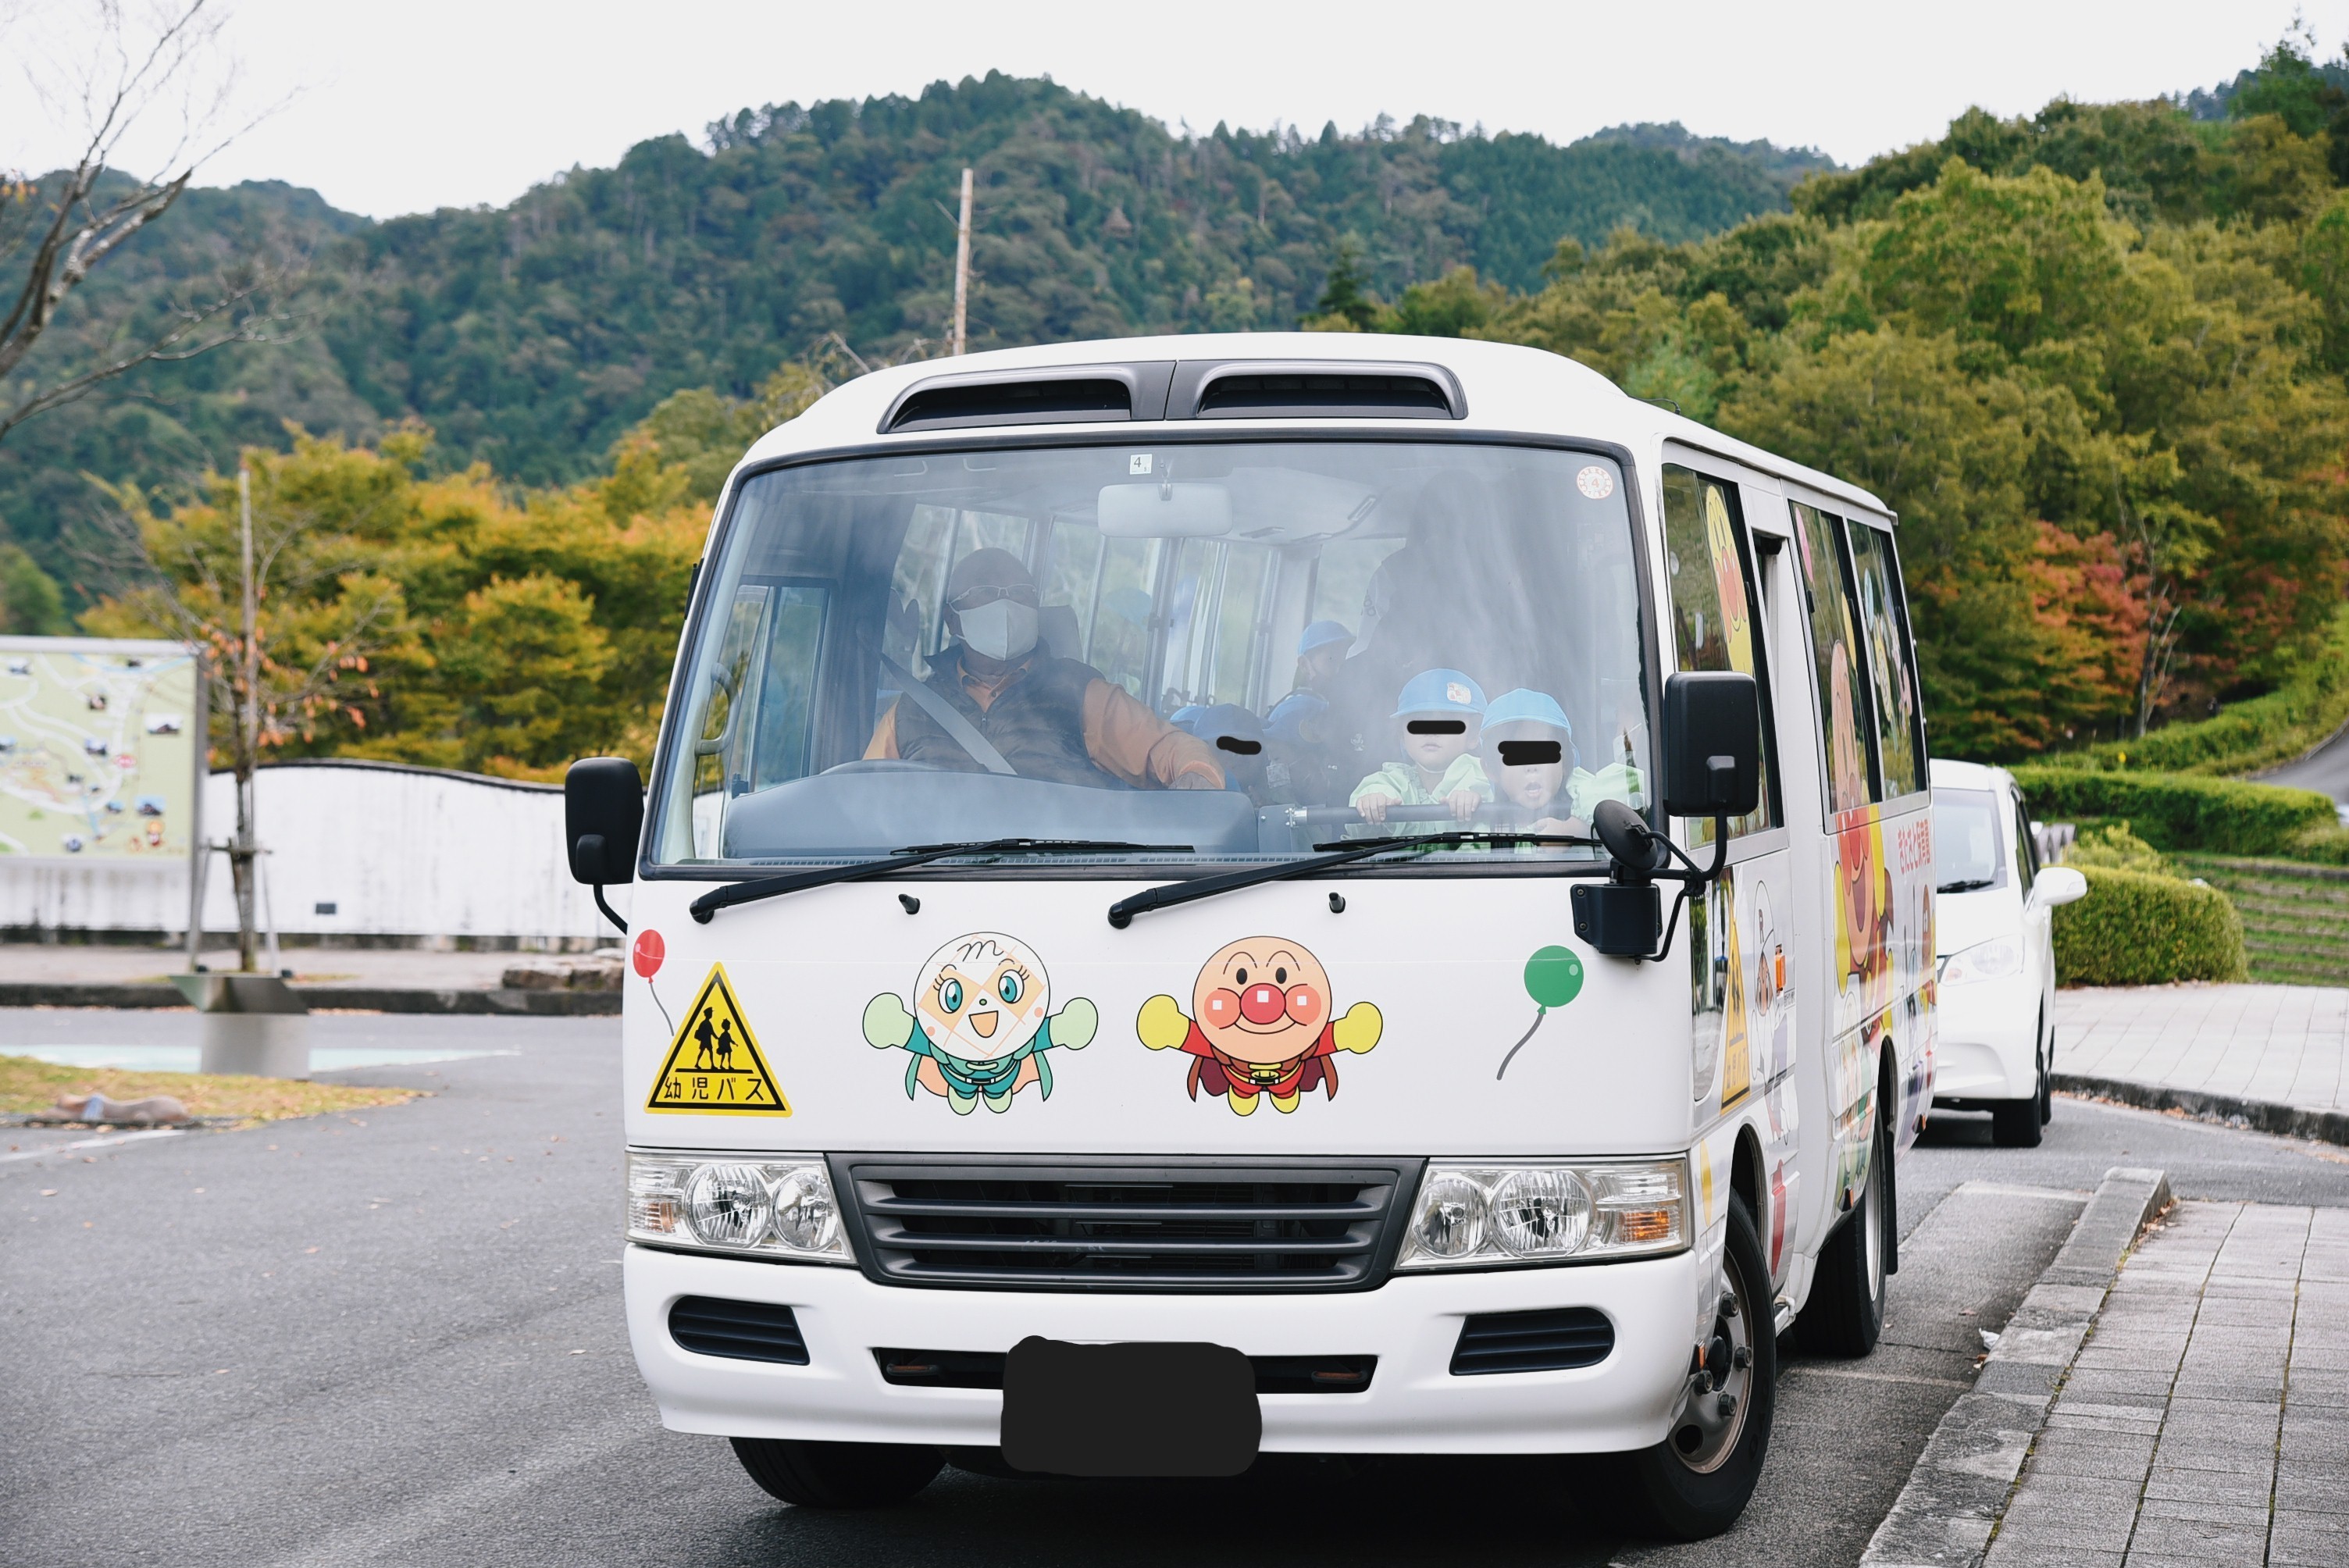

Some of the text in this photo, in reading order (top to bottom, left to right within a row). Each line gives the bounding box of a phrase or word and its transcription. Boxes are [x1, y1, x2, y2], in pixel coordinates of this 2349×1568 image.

[1134, 457, 1142, 468] 4
[1592, 478, 1600, 488] 4
[1898, 818, 1930, 875] きたさと保育園
[664, 1077, 764, 1101] 幼児バス
